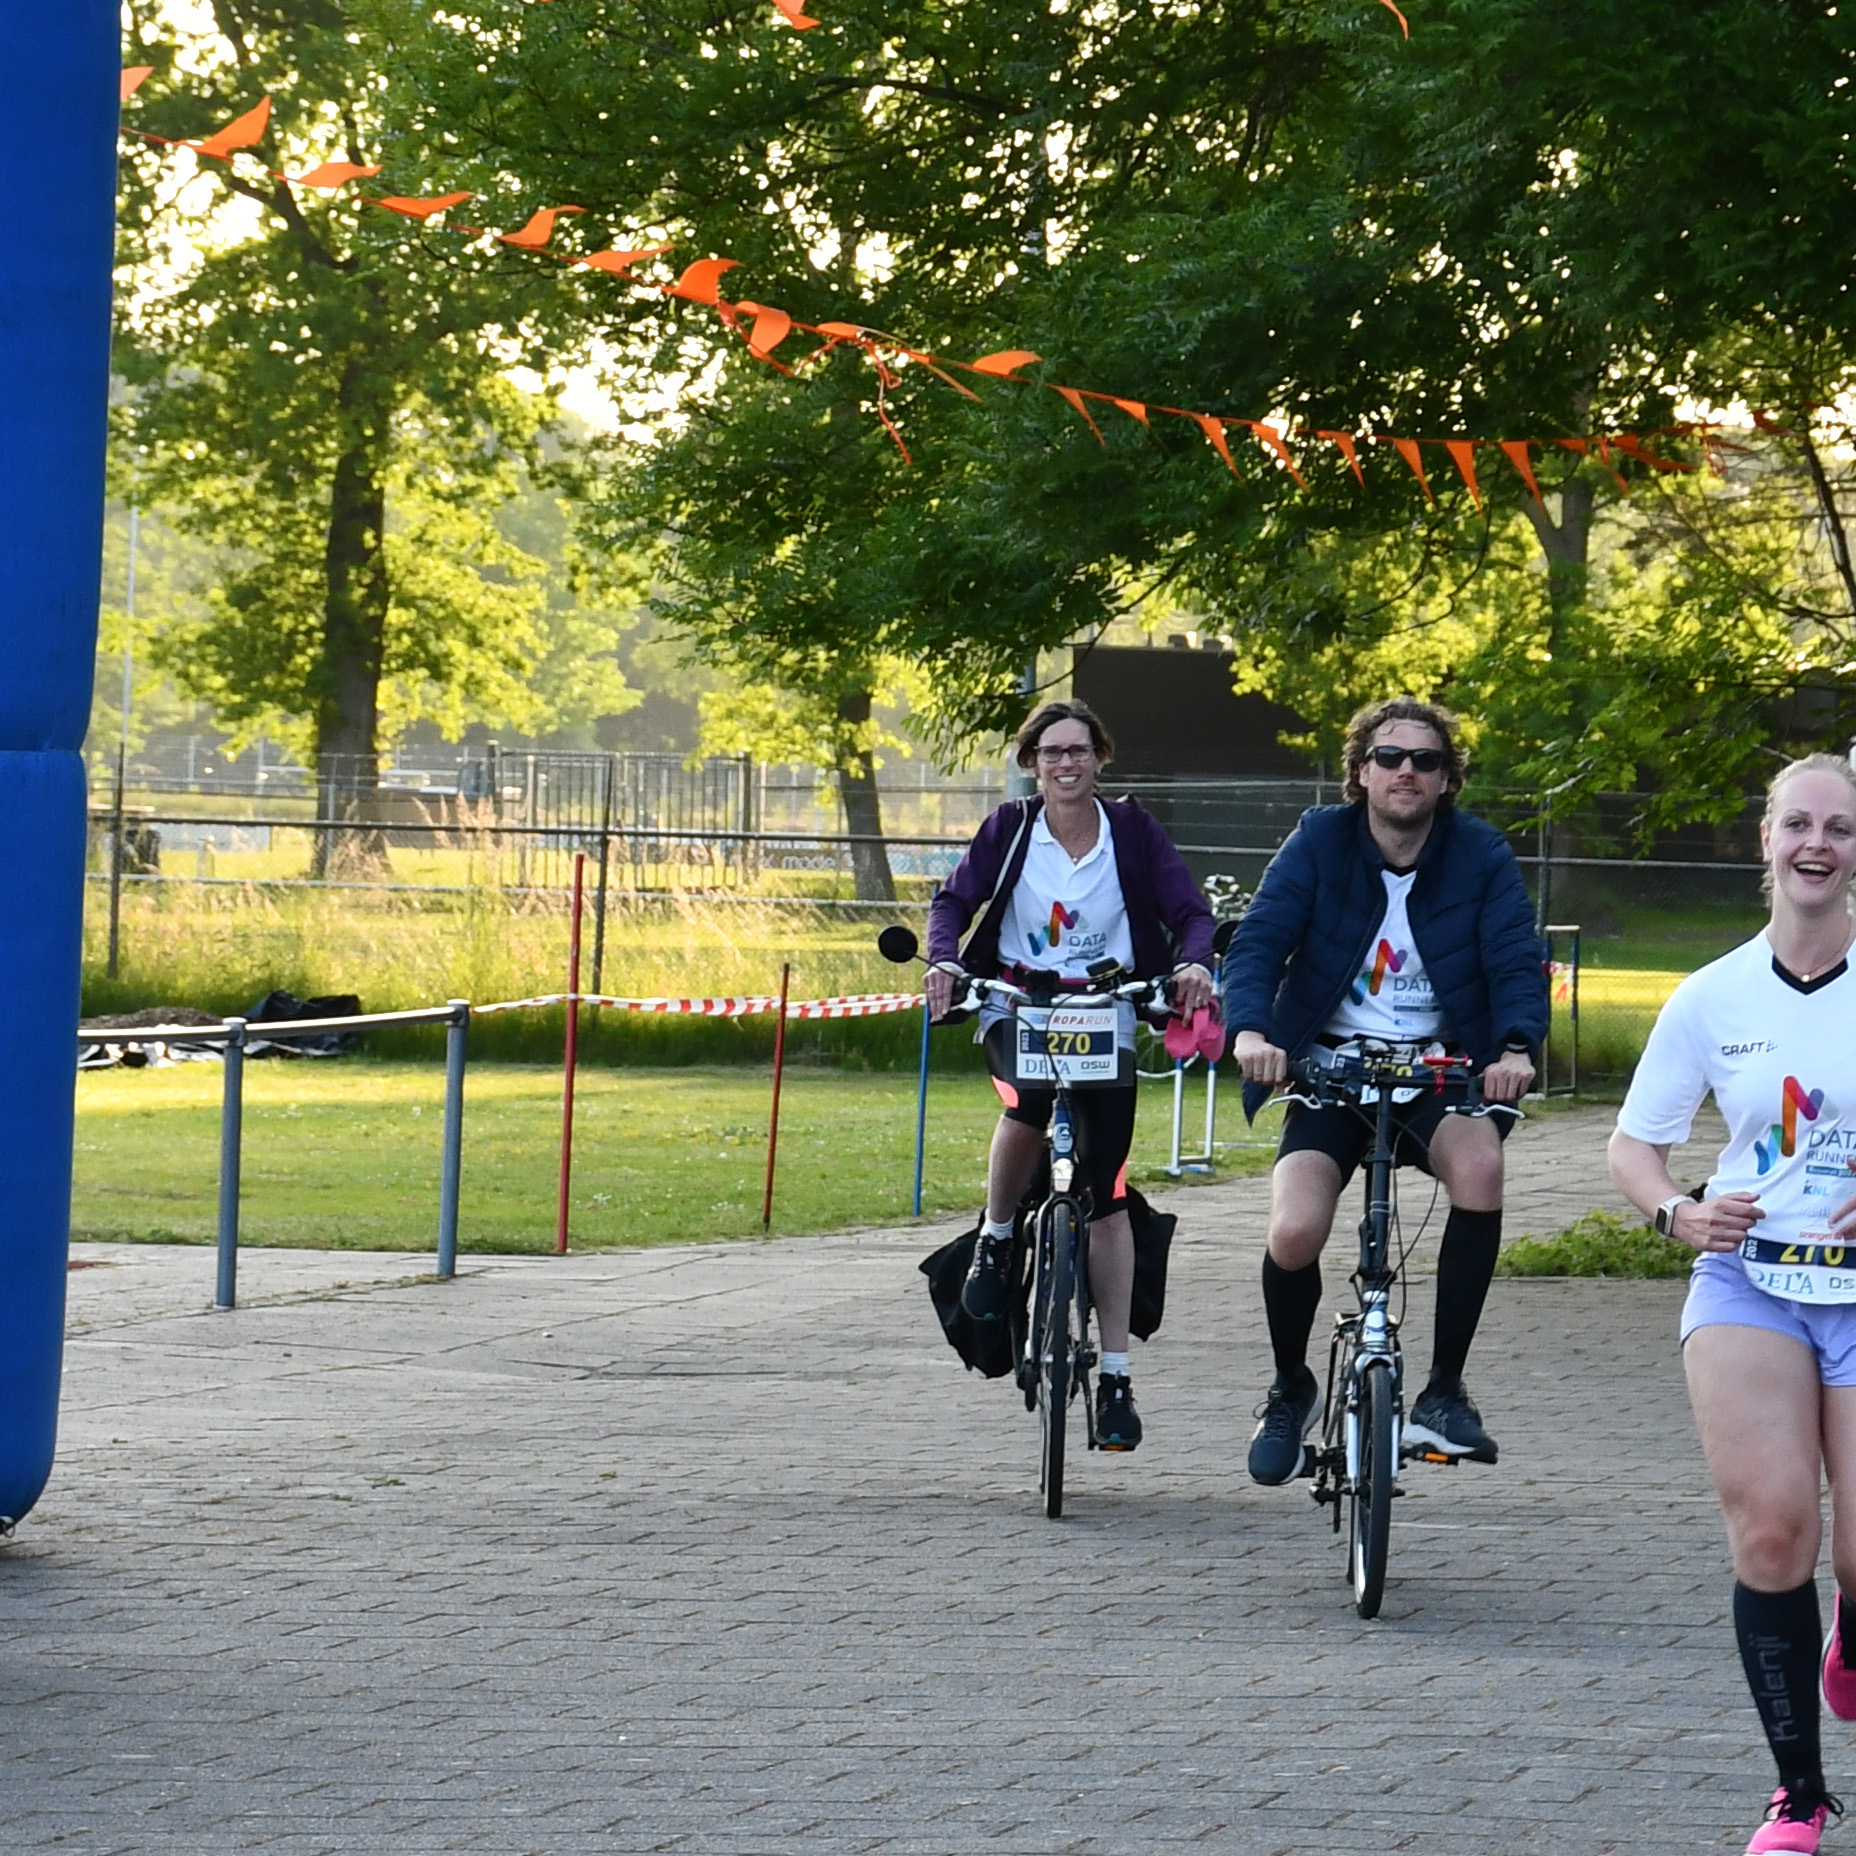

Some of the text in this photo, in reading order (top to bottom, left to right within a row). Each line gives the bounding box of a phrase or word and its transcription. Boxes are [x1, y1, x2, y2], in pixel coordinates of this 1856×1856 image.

[1069, 932, 1107, 948] DATA
[1046, 1031, 1091, 1054] 270
[1721, 1041, 1766, 1056] CRAFT
[1779, 1244, 1845, 1266] 270
